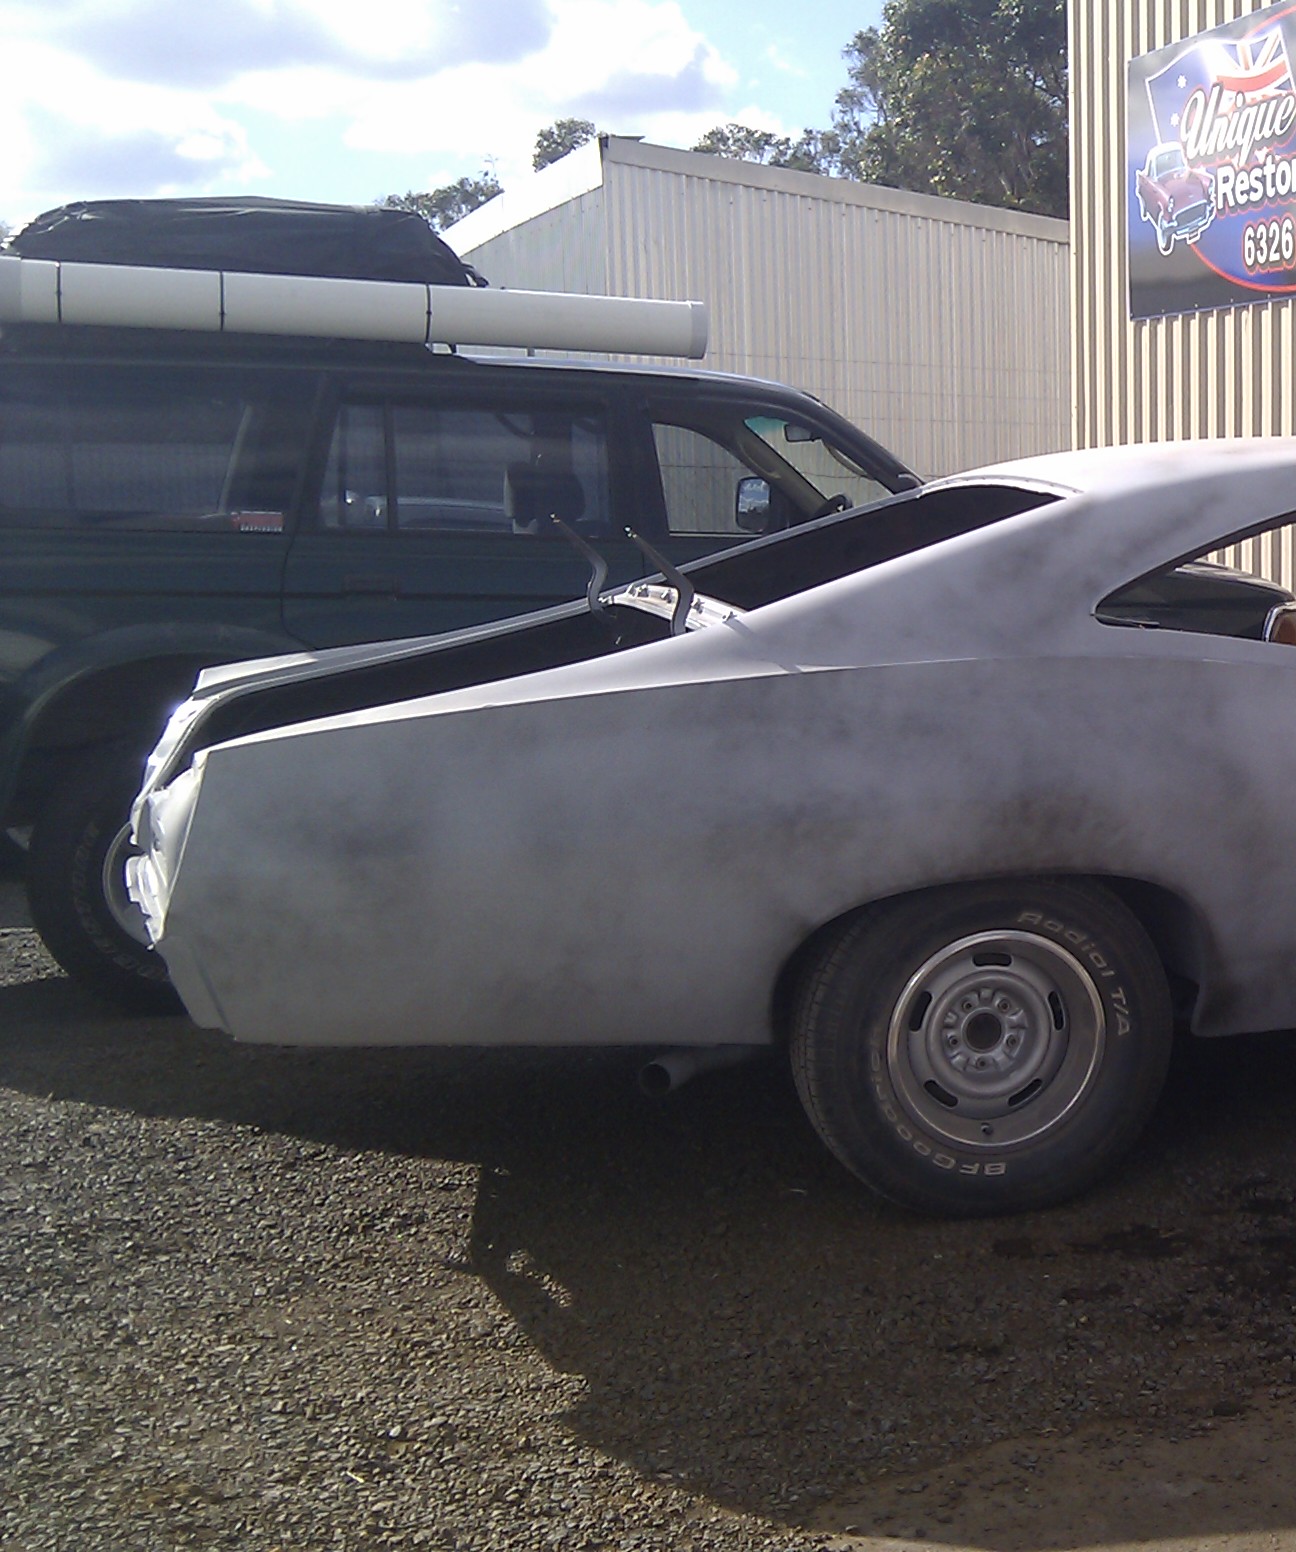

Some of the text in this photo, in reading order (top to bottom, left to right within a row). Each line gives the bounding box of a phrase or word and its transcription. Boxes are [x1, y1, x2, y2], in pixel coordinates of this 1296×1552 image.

[1244, 219, 1293, 267] 6326
[1016, 910, 1132, 1037] Radial T/A
